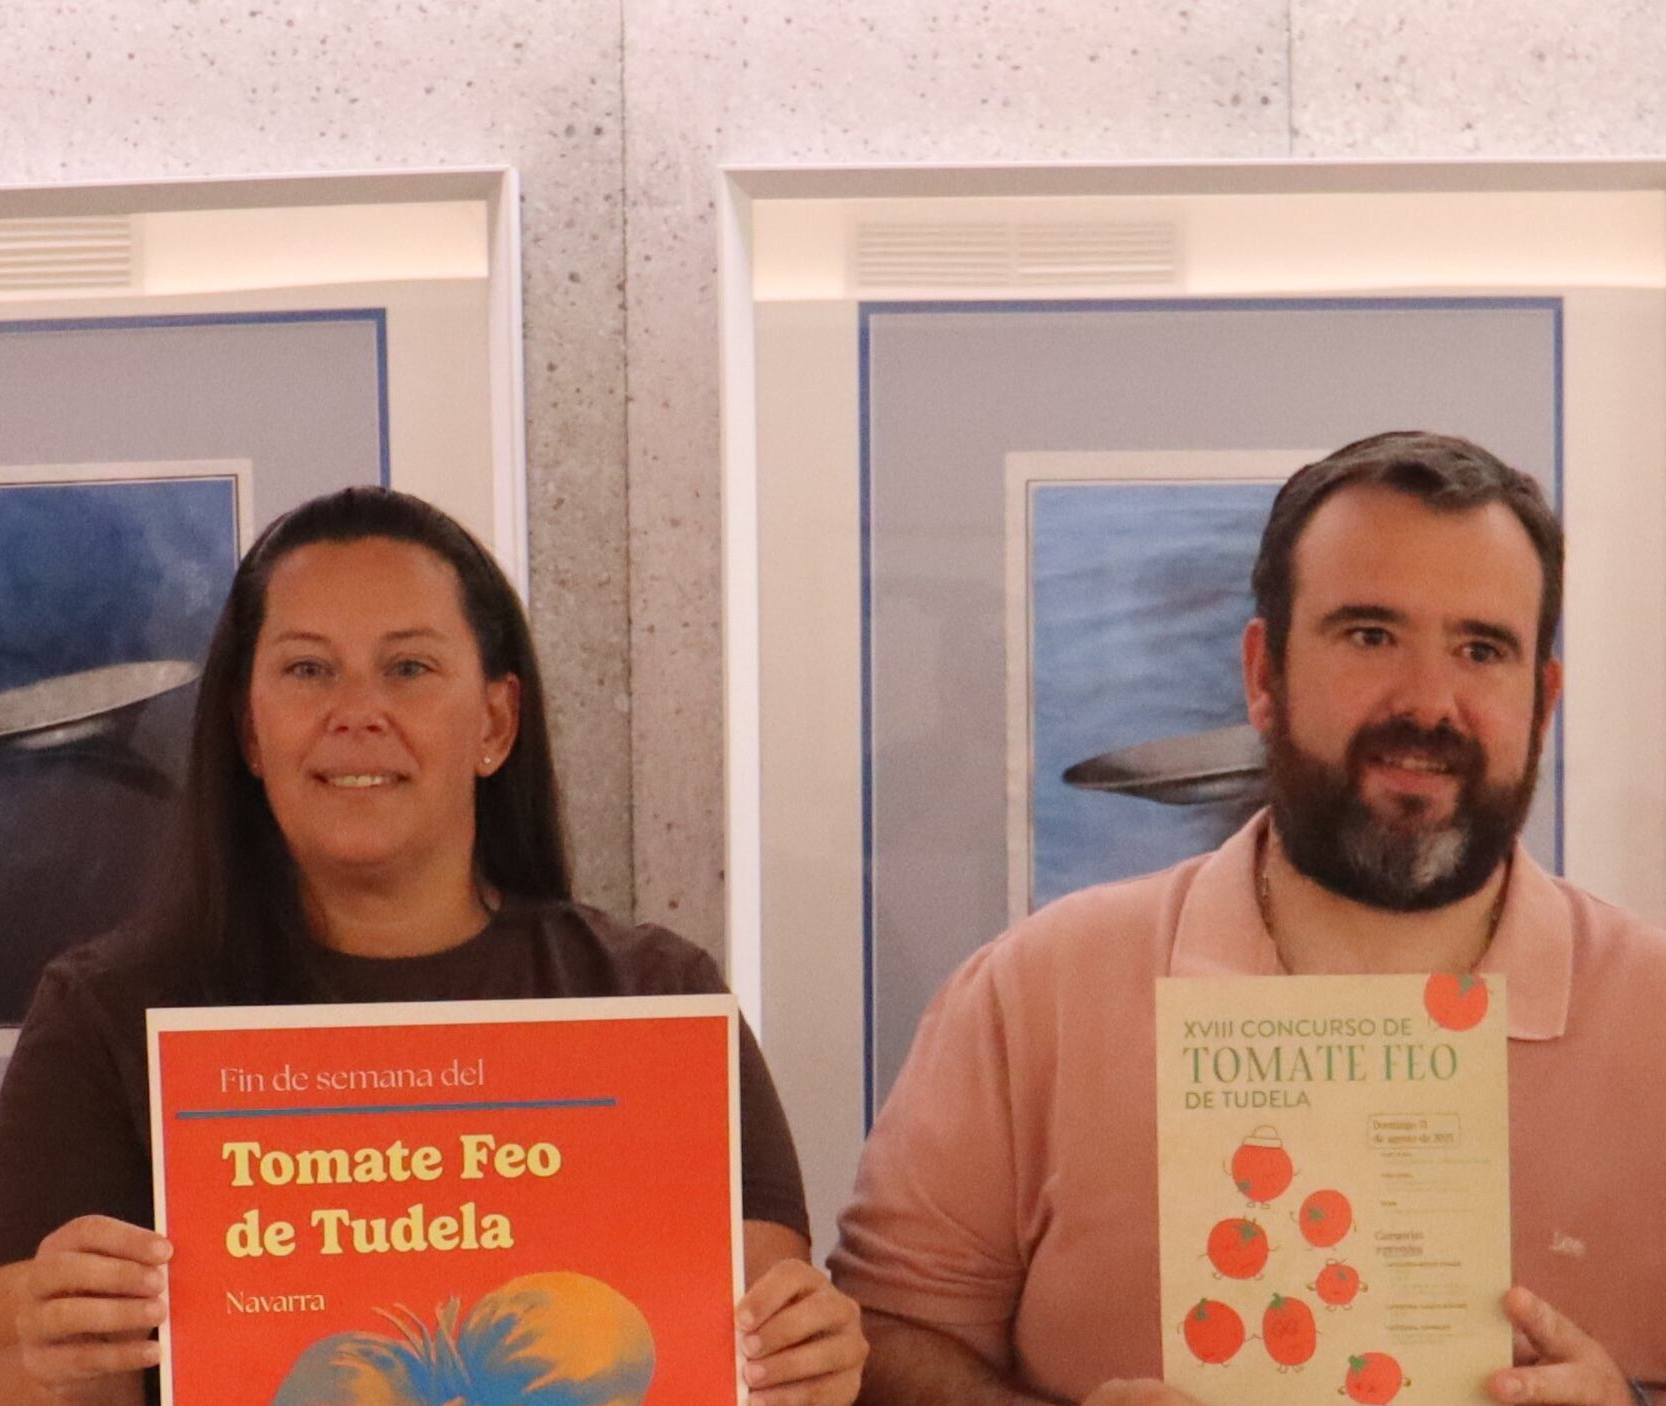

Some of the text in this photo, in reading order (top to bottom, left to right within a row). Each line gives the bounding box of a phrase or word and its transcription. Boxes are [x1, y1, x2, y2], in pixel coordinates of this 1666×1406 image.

[1183, 1018, 1413, 1040] XVIII CONCURSO DE
[219, 1058, 484, 1093] Fin de semana del
[1183, 1042, 1458, 1085] TOMATE FEO
[1184, 1089, 1311, 1110] DE TUDELA
[221, 1133, 562, 1187] Tomate Feo
[225, 1202, 515, 1258] de Tudela
[226, 1293, 327, 1314] Navarra
